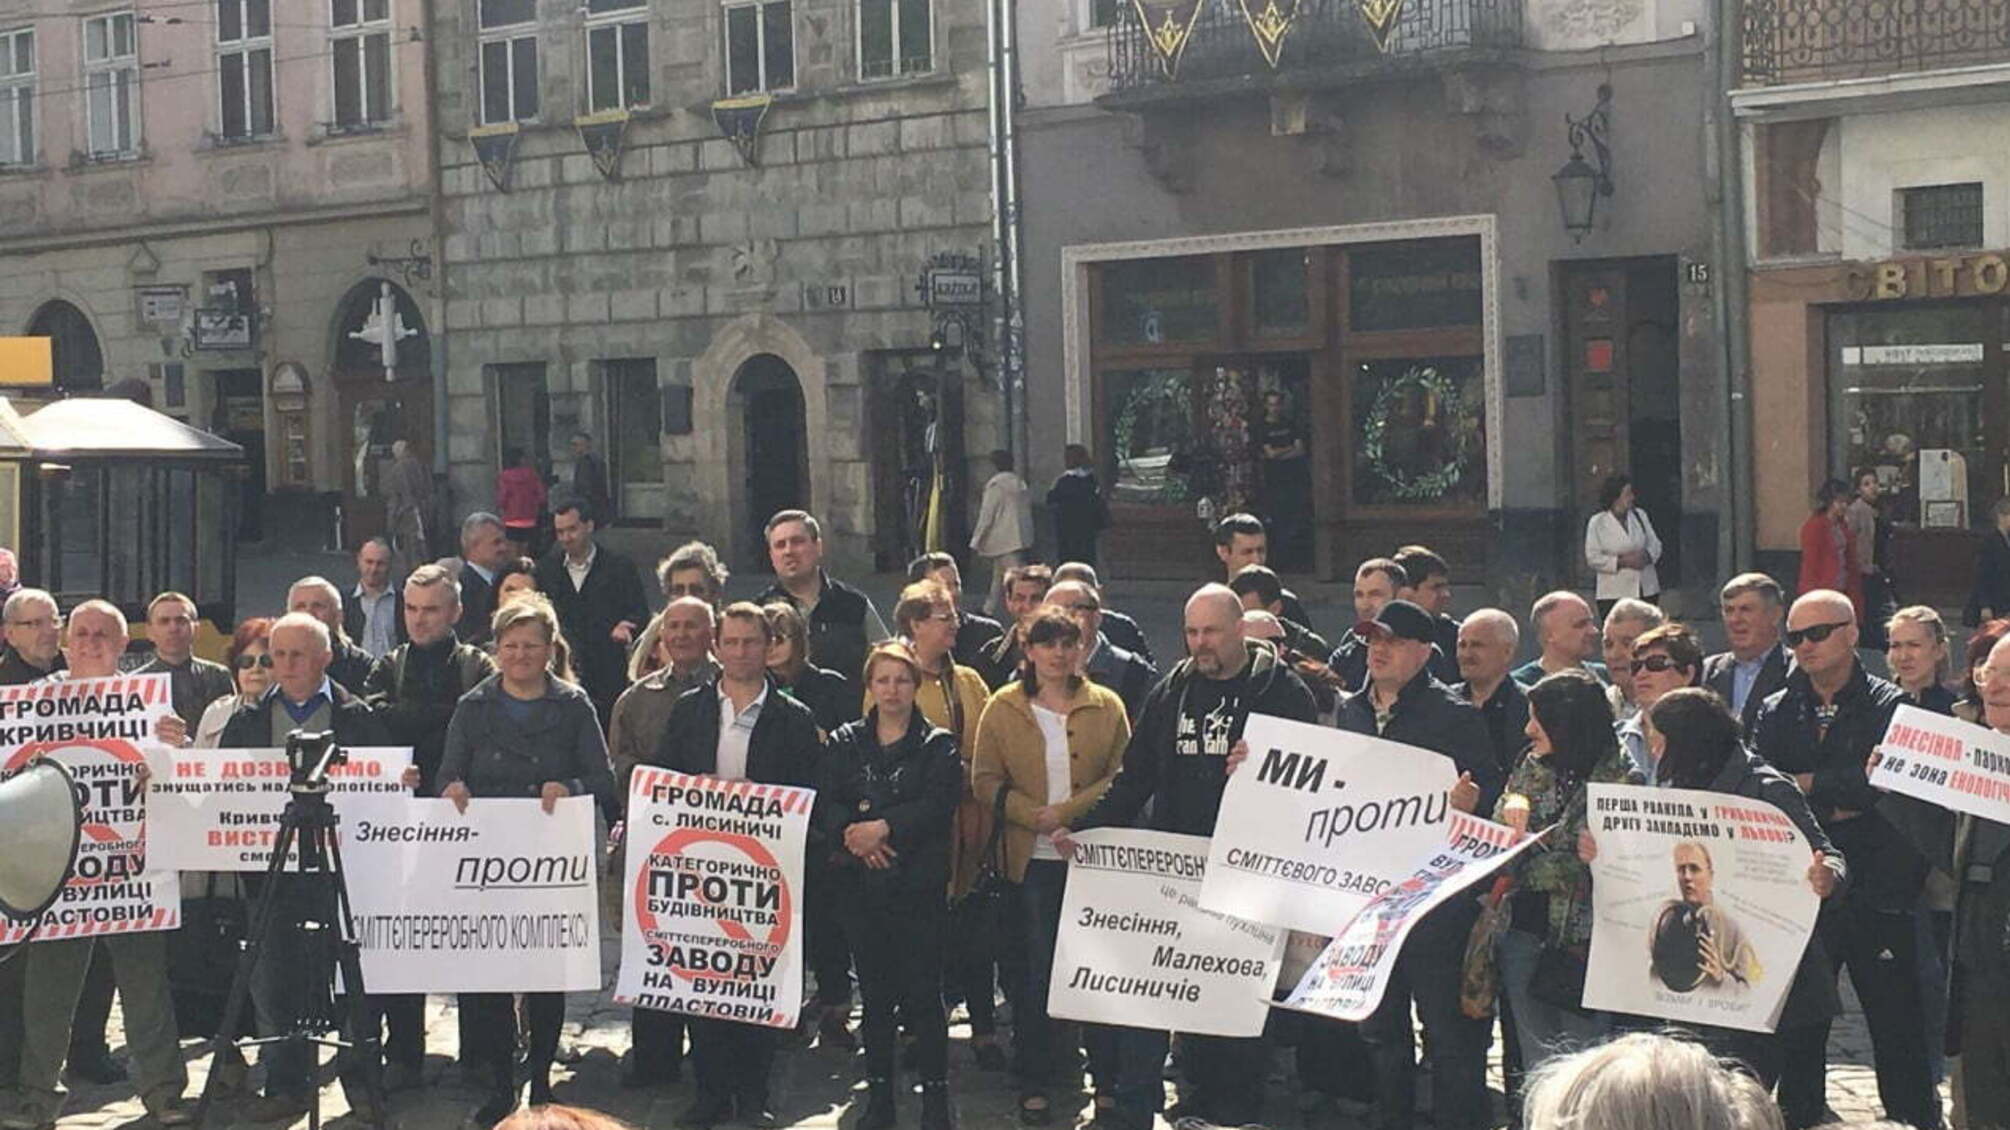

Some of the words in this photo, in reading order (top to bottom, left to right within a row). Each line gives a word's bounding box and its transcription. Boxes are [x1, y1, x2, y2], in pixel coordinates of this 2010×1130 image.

[1688, 264, 1708, 283] 15
[0, 692, 145, 720] ГРОМАДА
[0, 719, 147, 746] КРИВЧИЦІ
[1887, 723, 1963, 761] ЗНЕСІННЯ
[176, 762, 206, 777] НЕ
[1257, 748, 1328, 794] МИ
[1884, 756, 1905, 774] не
[1910, 763, 1948, 786] зона
[651, 785, 784, 819] ГРОМАДА
[1597, 798, 1638, 812] ПЕРША
[355, 821, 480, 842] Знесіння-
[675, 812, 782, 840] ЛИСИНИЧІ
[1304, 790, 1449, 848] проти
[1603, 816, 1641, 831] ДРУГУ
[1646, 819, 1719, 837] ЗАКЛАДЕМО
[455, 856, 589, 892] проти
[649, 854, 782, 882] КАТЕГОРИЧНО
[1226, 847, 1335, 886] СМІТТЄВОГО
[62, 881, 151, 902] ВУЛИЦІ
[648, 870, 781, 911] ПРОТИ
[647, 899, 779, 926] БУДІВНИЦТВА
[1077, 907, 1182, 939] Знесіння,
[511, 912, 590, 949] КОМПЛЕКСУ
[646, 944, 778, 982] ЗАВОДУ
[1152, 945, 1268, 979] Малехова,
[643, 970, 673, 990] НА
[692, 977, 776, 1002] ВУЛИЦІ
[1068, 967, 1201, 1001] Лисиничів
